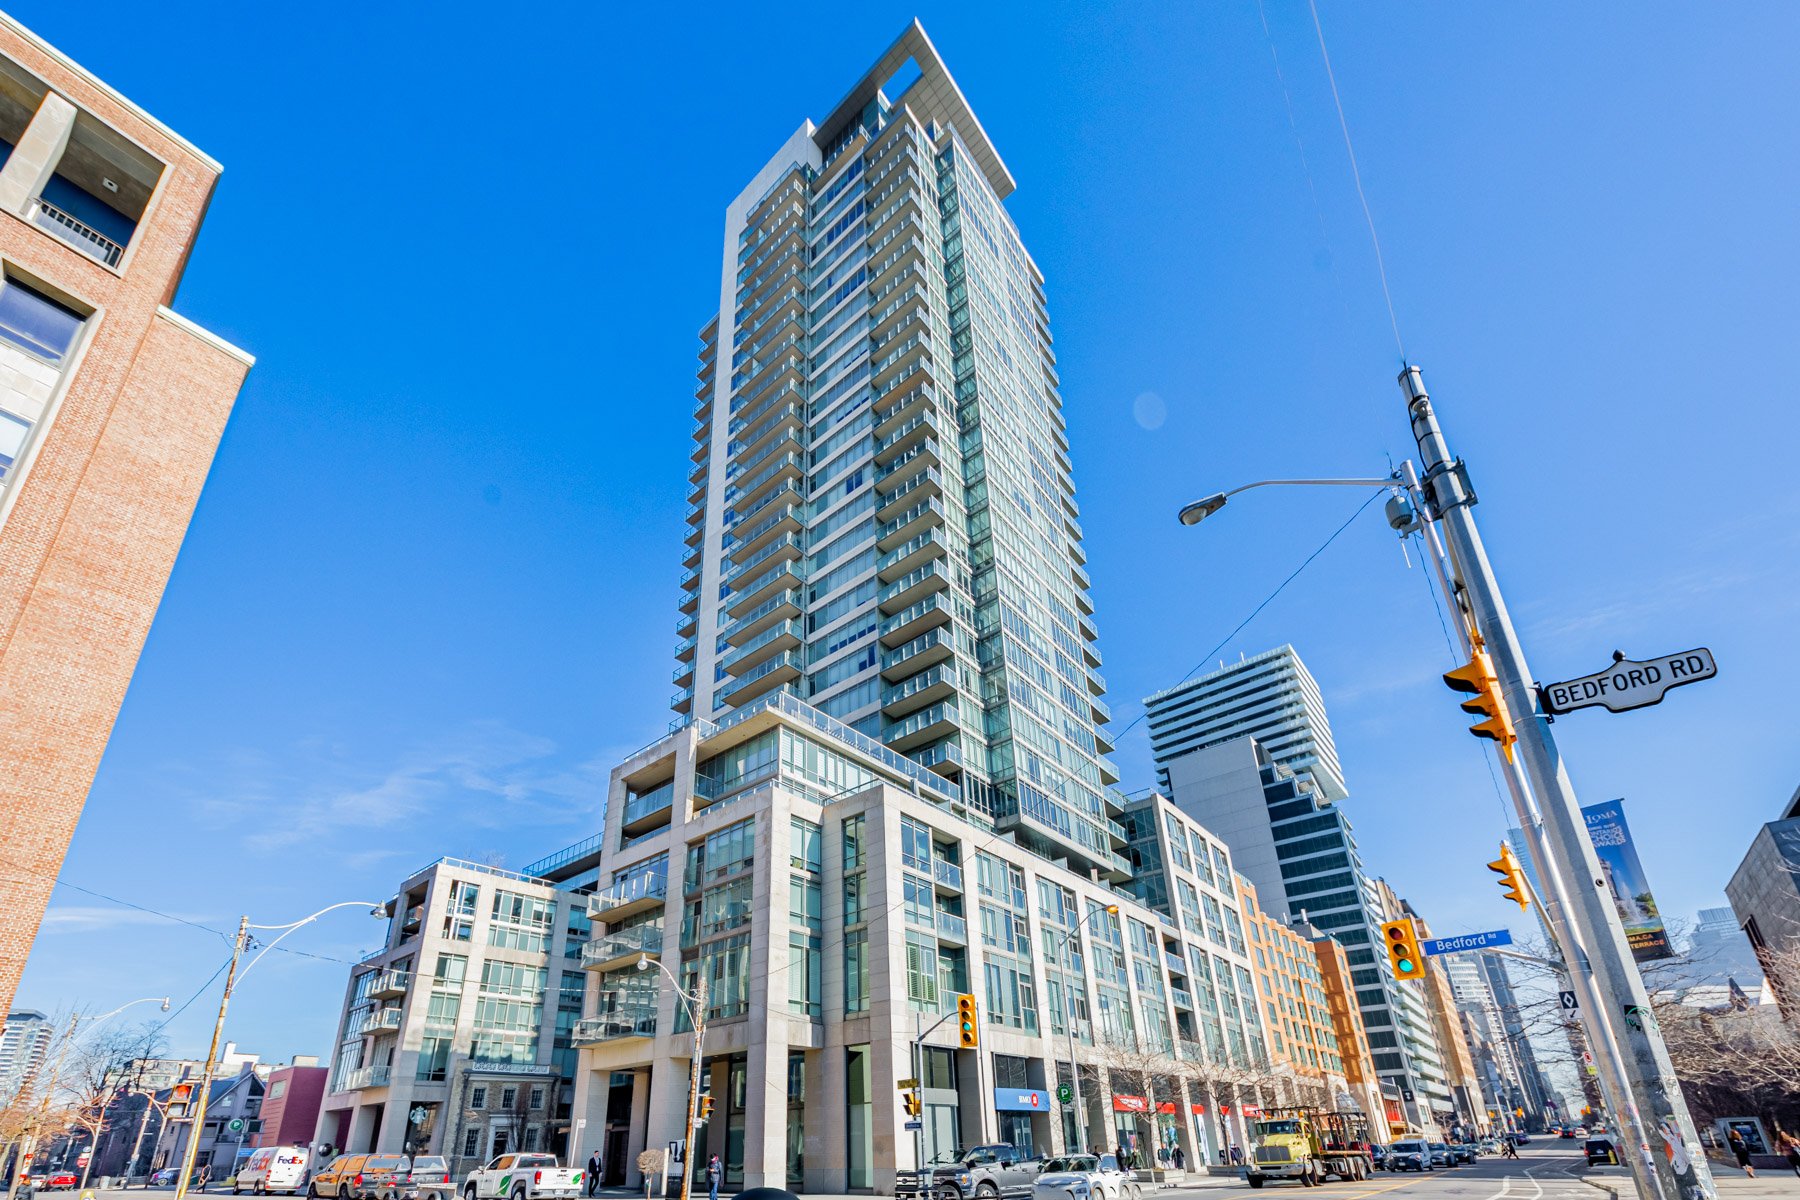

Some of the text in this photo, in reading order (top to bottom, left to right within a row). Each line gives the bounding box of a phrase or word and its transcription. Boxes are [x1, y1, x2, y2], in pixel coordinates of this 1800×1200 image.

[1553, 655, 1711, 706] BEDFORD RD.
[1435, 934, 1486, 951] Bedford
[1061, 1088, 1069, 1098] P
[277, 1155, 304, 1165] FedEx
